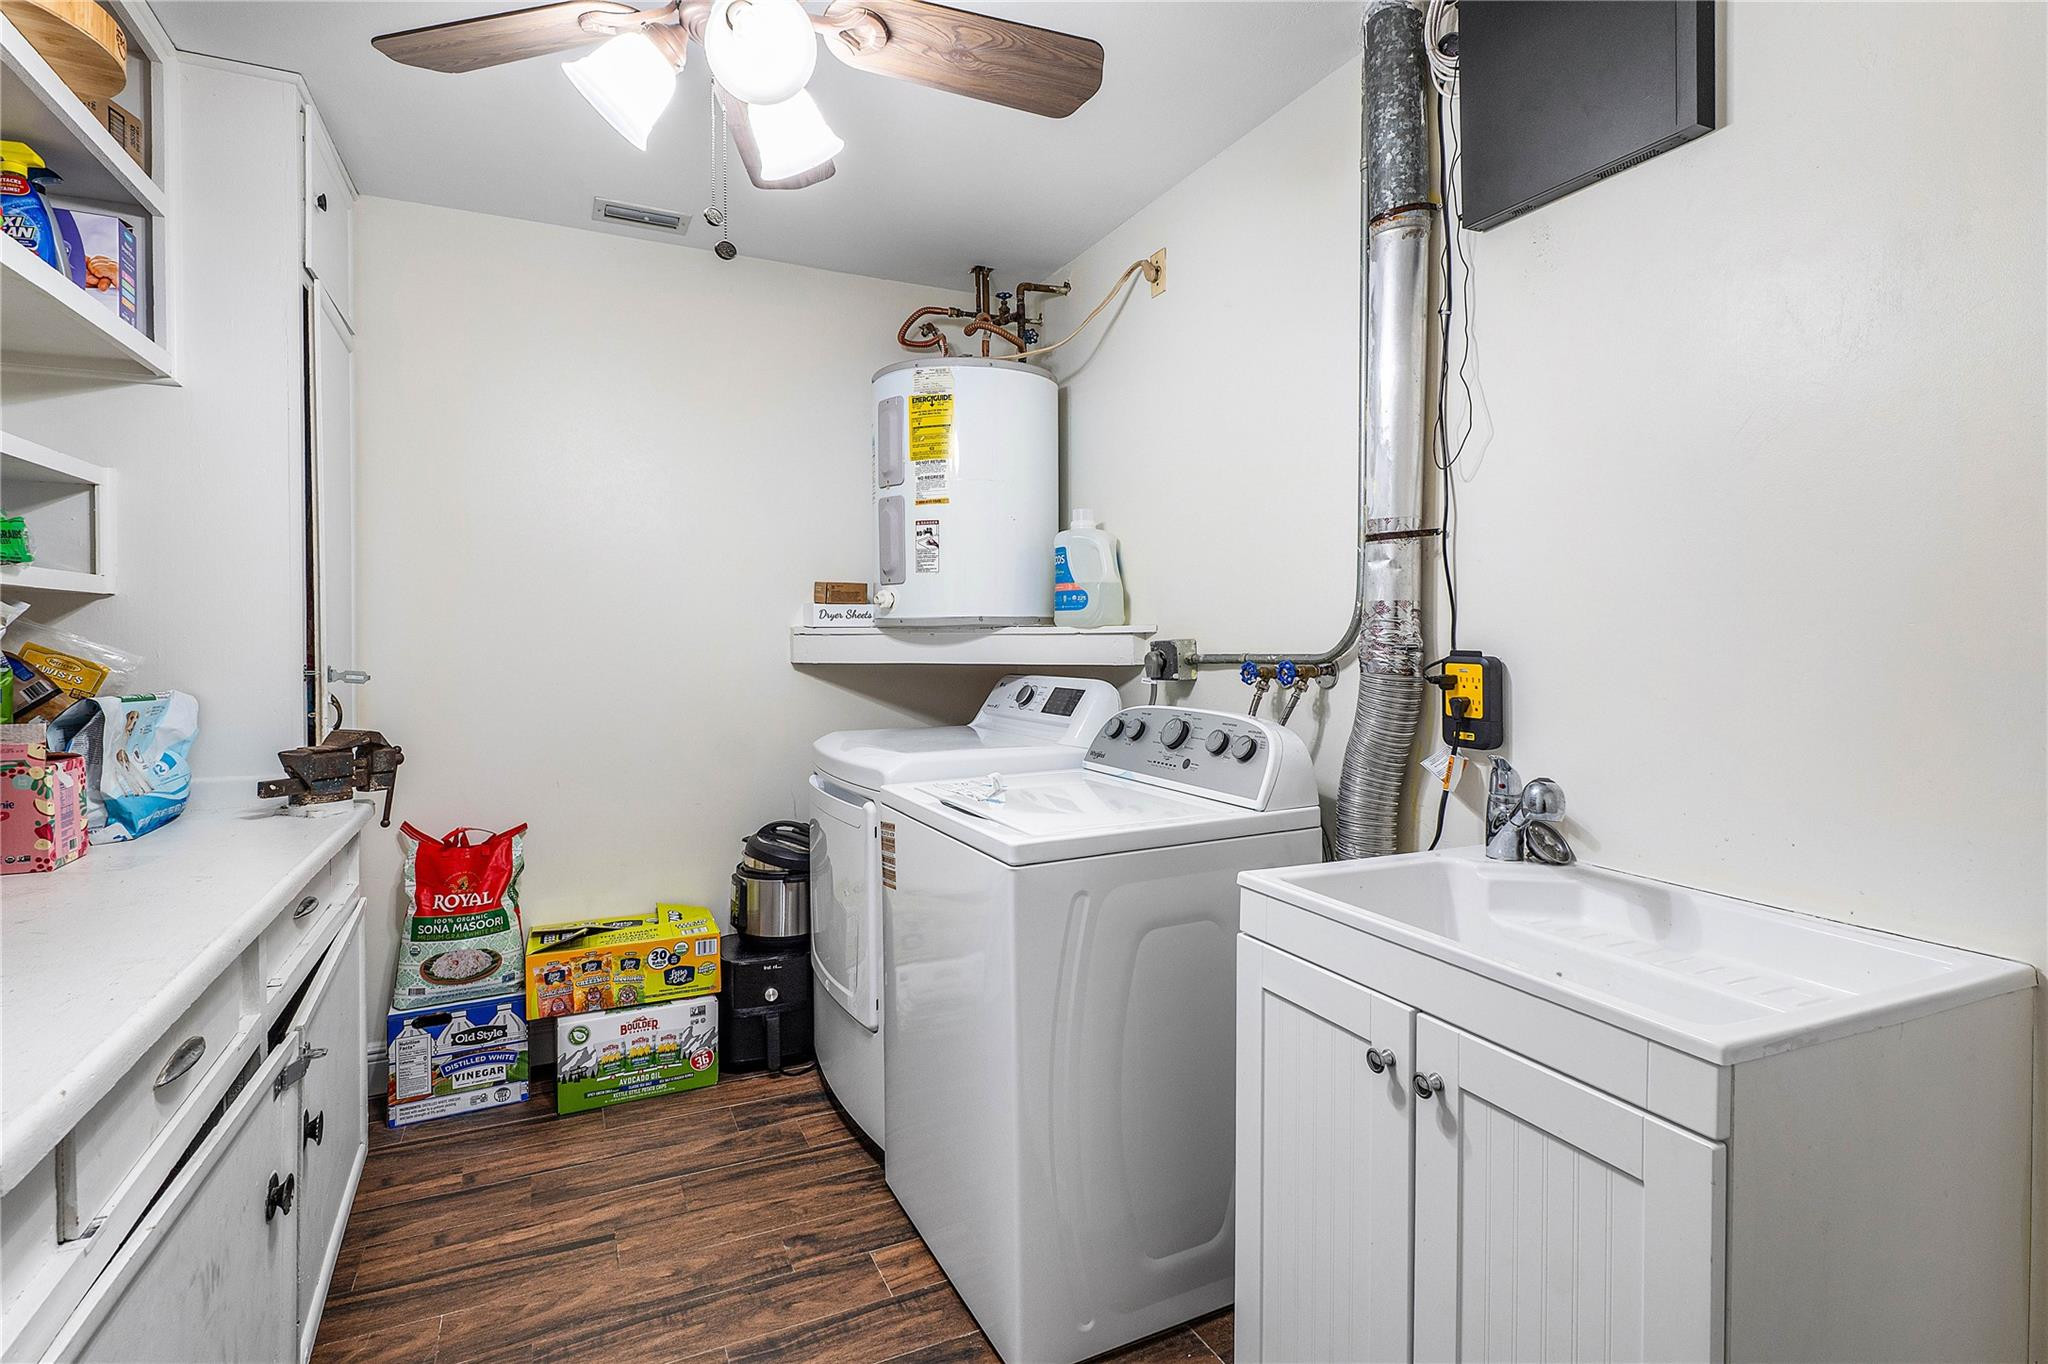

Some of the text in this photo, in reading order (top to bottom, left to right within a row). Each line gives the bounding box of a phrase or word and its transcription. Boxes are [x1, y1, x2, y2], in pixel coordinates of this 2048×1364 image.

[3, 216, 24, 226] XI
[818, 608, 872, 621] Dryer Sheets
[432, 891, 494, 912] ROYAL
[417, 916, 504, 935] SONA MASOORI
[433, 913, 488, 925] 100% ORGANIC
[651, 950, 667, 961] 30
[620, 1019, 658, 1035] BOULDER
[455, 1029, 504, 1044] Old Style
[444, 1055, 486, 1072] DISTILLED
[695, 1053, 709, 1067] 36
[453, 1066, 504, 1081] VINEGAR
[619, 1074, 651, 1086] AVOCADO
